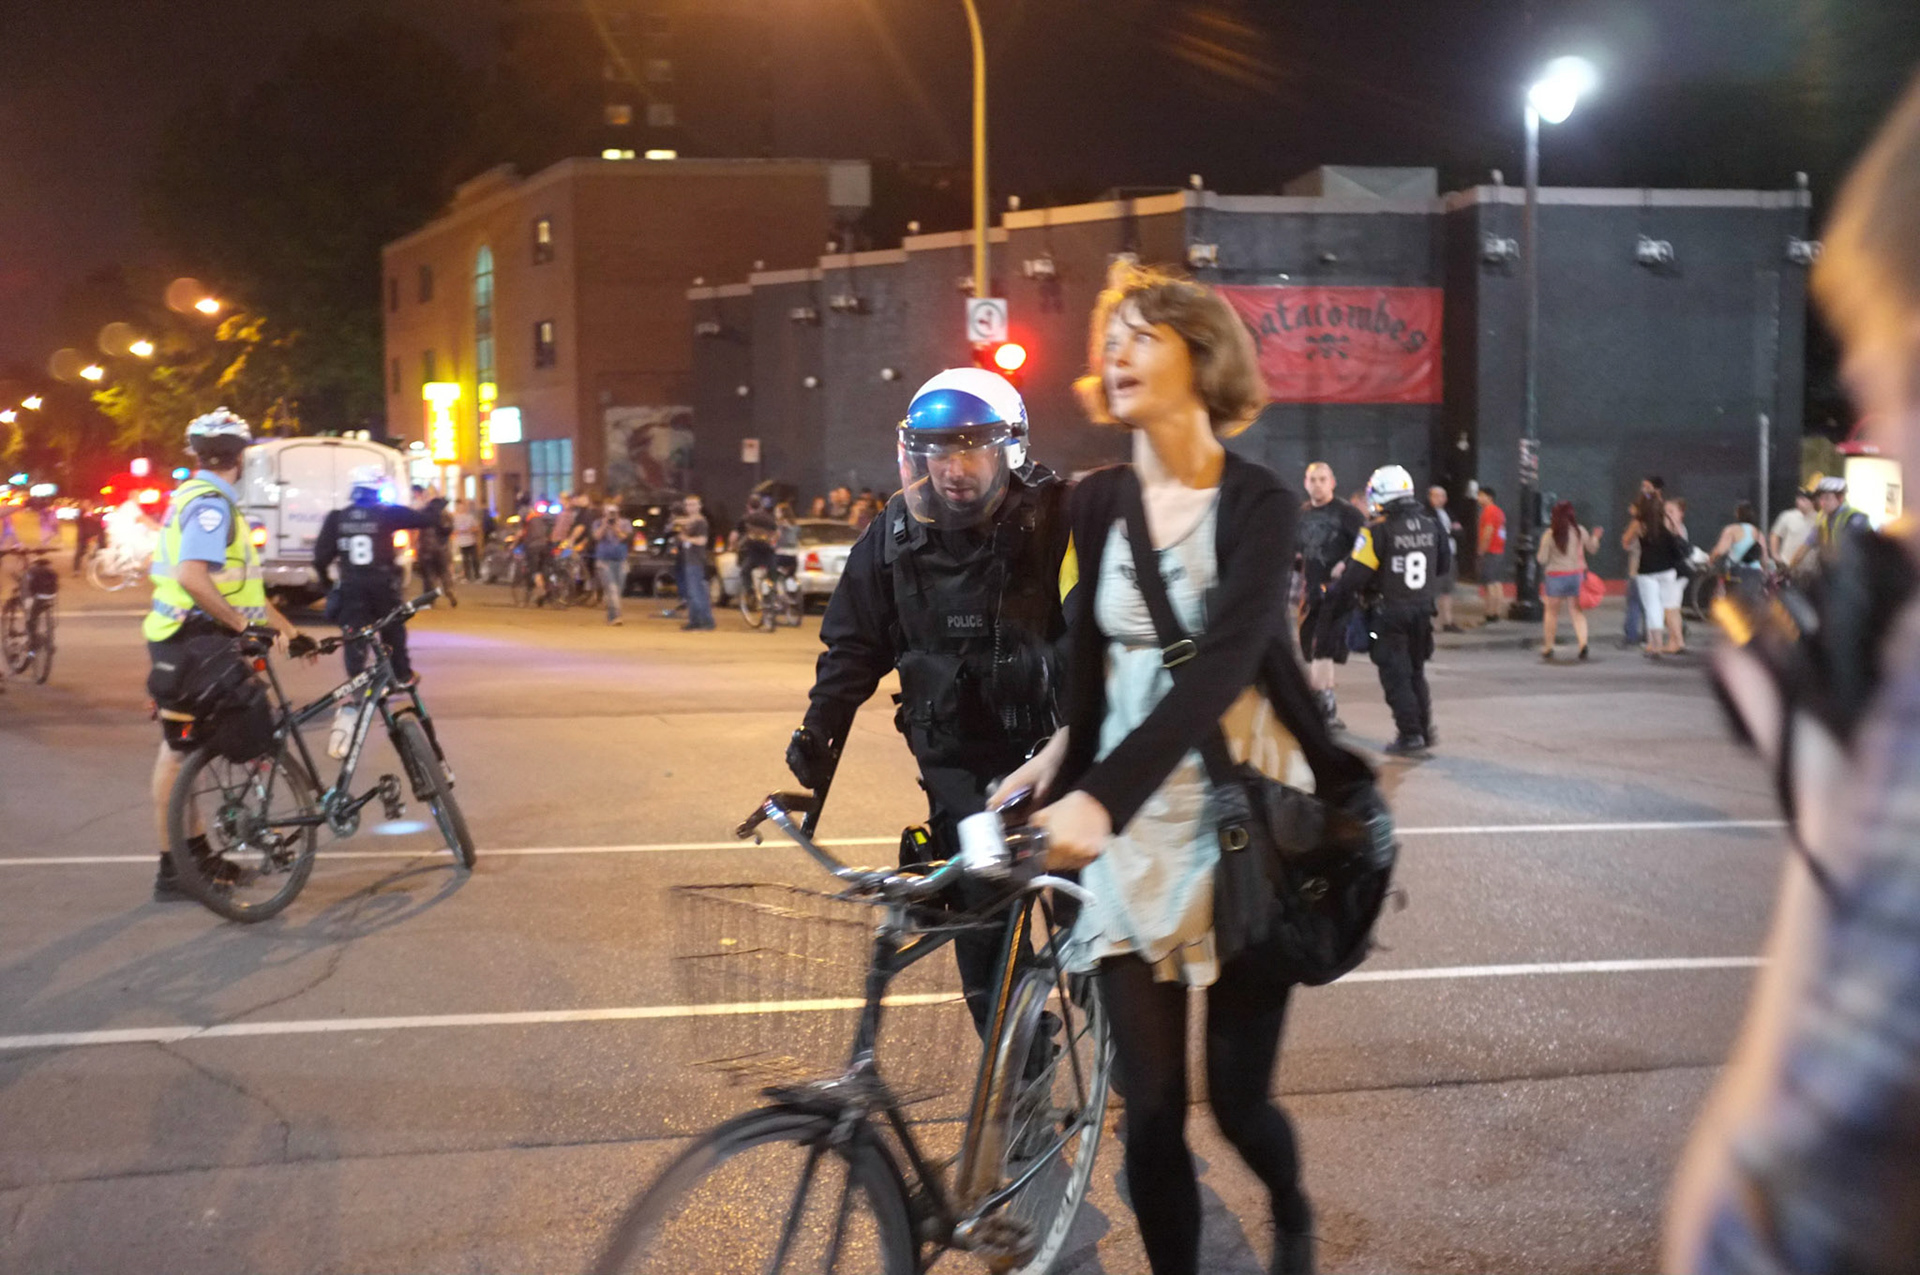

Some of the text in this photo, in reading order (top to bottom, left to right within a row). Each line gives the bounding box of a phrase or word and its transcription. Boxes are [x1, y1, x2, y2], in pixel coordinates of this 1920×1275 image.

[1244, 297, 1427, 356] atacombes
[1394, 532, 1434, 549] POLICE
[947, 614, 982, 628] POLICE
